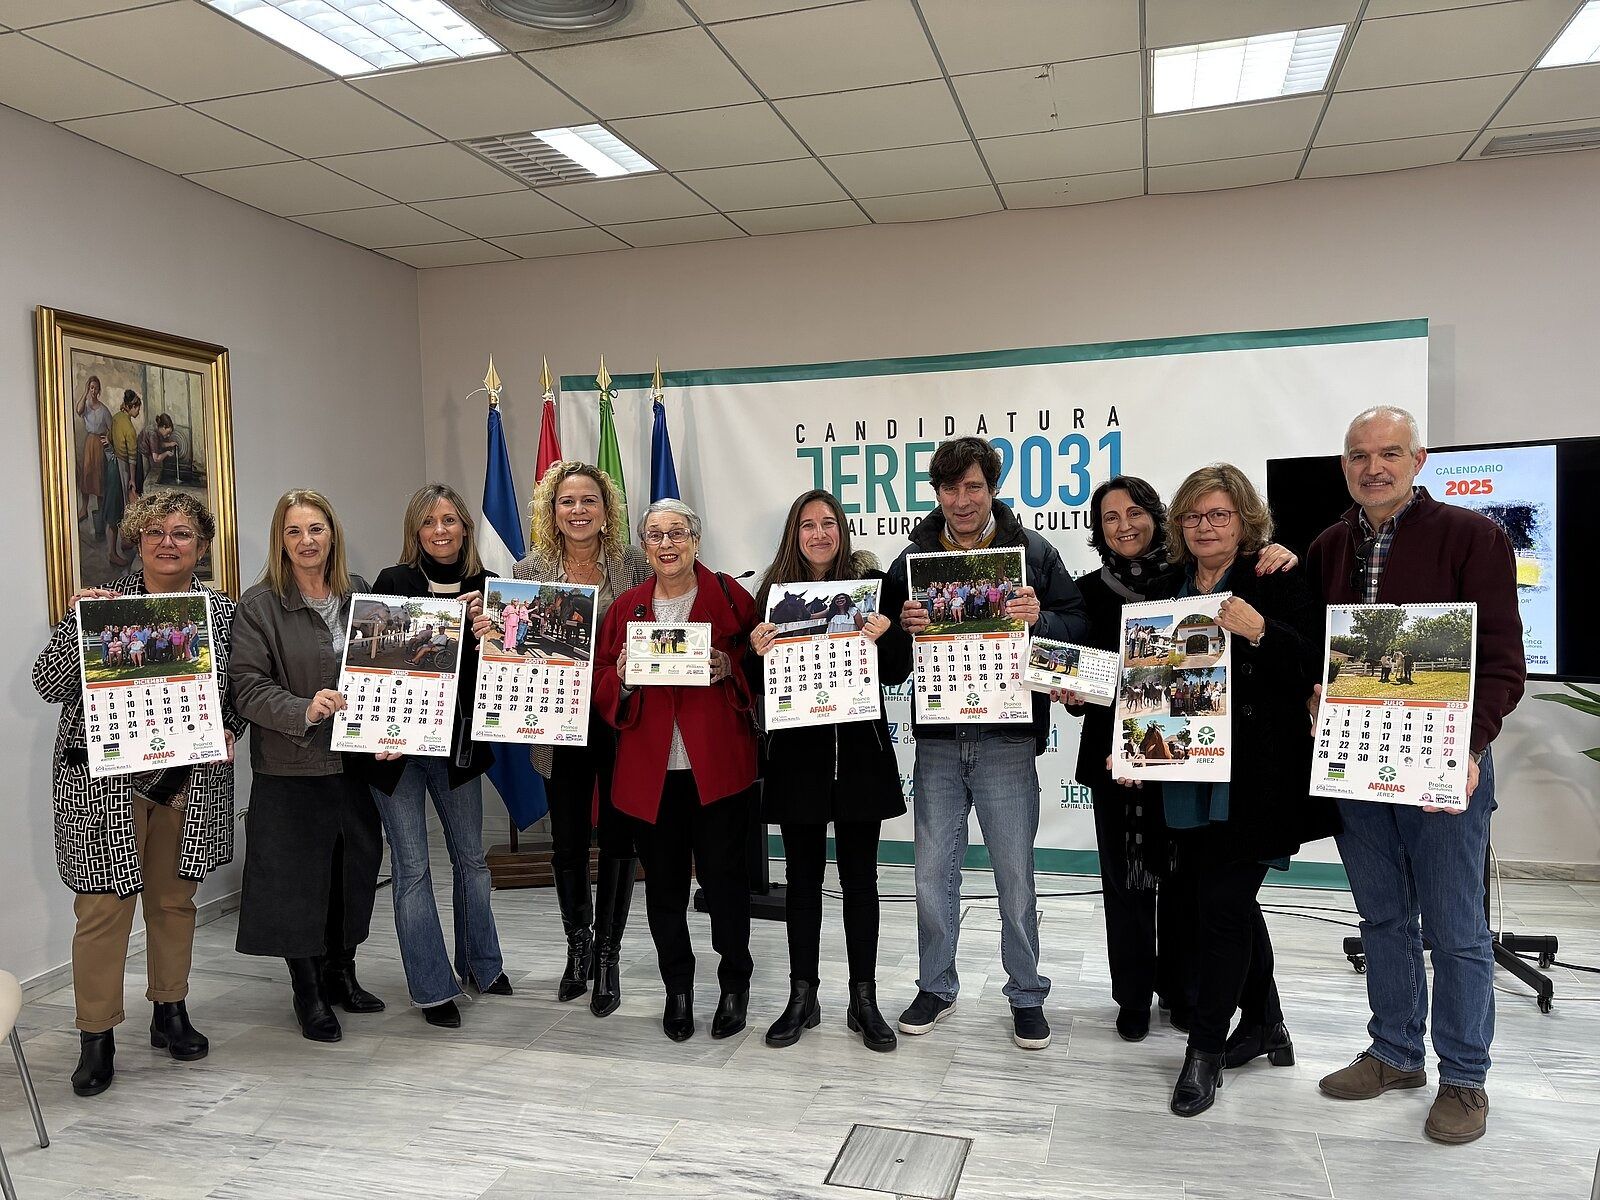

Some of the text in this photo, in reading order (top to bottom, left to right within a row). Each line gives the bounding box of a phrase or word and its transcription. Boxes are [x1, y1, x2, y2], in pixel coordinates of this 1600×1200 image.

[796, 405, 1121, 443] CANDIDATURA
[1435, 463, 1504, 476] CALENDARIO
[796, 441, 938, 514] JERE
[1445, 478, 1494, 496] 2025
[1034, 510, 1091, 531] CULTU
[829, 670, 837, 678] 24
[933, 665, 940, 673] 16
[134, 678, 167, 686] DICIEMBRE
[146, 708, 154, 716] 18
[809, 704, 837, 714] AFANAS
[959, 707, 988, 715] AFANAS
[1365, 709, 1371, 718] 2
[1385, 711, 1391, 719] 3
[1405, 712, 1411, 720] 4
[1448, 713, 1454, 722] 6
[516, 727, 545, 735] AFANAS
[1364, 720, 1370, 728] 9
[1382, 721, 1392, 730] 10
[1404, 723, 1412, 731] 11
[1446, 725, 1455, 733] 13
[378, 738, 407, 746] AFANAS
[1322, 729, 1331, 737] 14
[1361, 731, 1370, 739] 16
[1382, 733, 1390, 741] 17
[1402, 734, 1411, 742] 18
[1423, 735, 1433, 744] 19
[1443, 736, 1455, 745] 20
[1187, 747, 1225, 757] AFANAS
[1320, 739, 1453, 757] 21 22 23 24 25 26 27
[143, 750, 176, 761] AFANAS
[1318, 750, 1388, 764] 28 29 30 31
[1367, 782, 1406, 792] AFANAS
